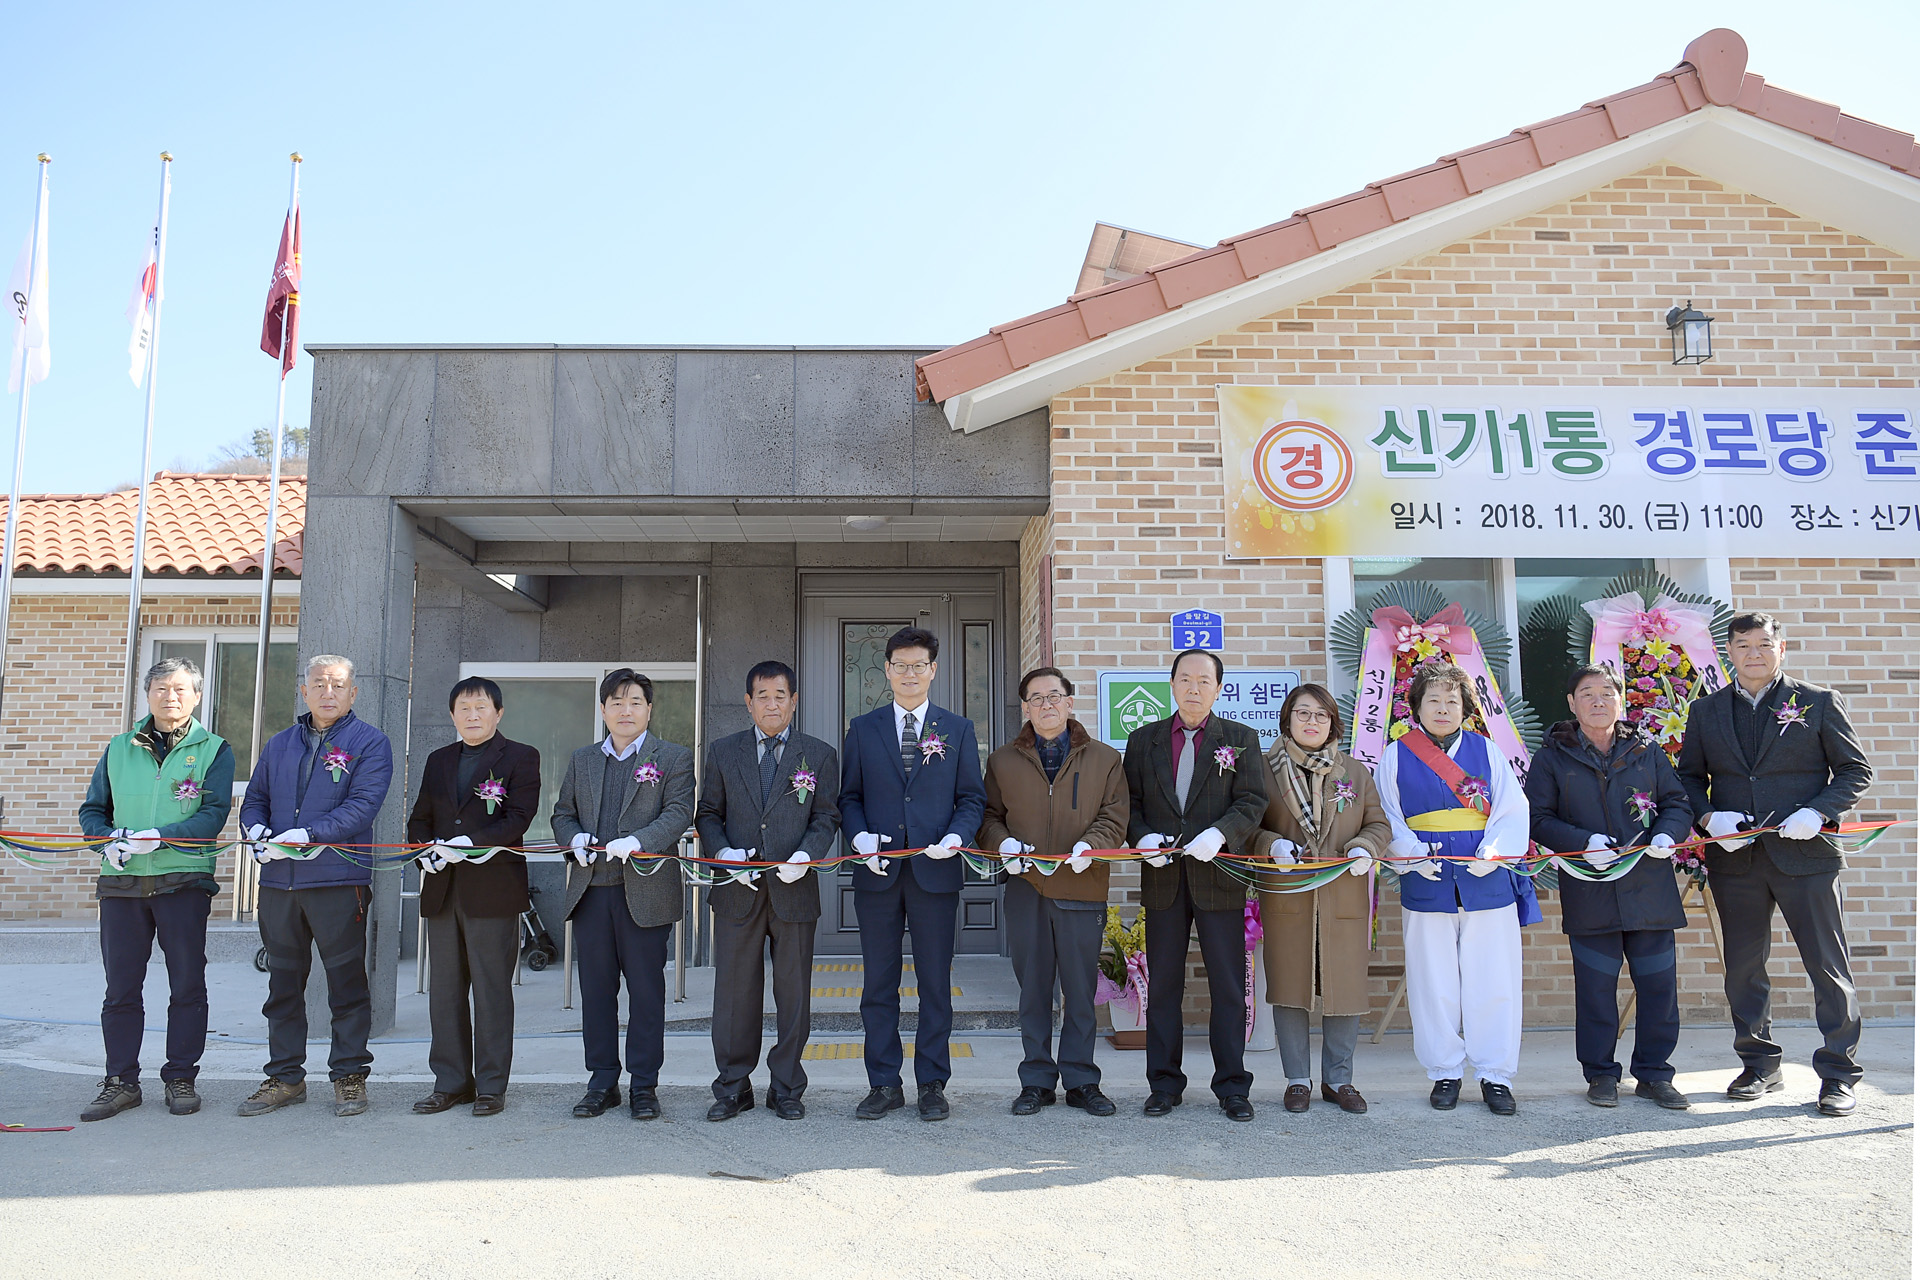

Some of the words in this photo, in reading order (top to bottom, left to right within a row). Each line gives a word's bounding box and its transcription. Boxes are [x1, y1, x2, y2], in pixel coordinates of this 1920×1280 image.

[1371, 410, 1607, 474] 신기1통
[1633, 411, 1828, 476] 경로당
[1855, 413, 1918, 475] 준
[1280, 444, 1323, 489] 경
[1390, 502, 1443, 530] 일시
[1480, 503, 1543, 530] 2018.
[1554, 504, 1588, 530] 11.
[1598, 504, 1633, 530] 30.
[1644, 501, 1690, 532] (금)
[1700, 504, 1763, 529] 11:00
[1790, 503, 1843, 531] 장소
[1184, 630, 1211, 648] 32
[1216, 682, 1240, 702] 위
[1249, 682, 1289, 705] 쉼터
